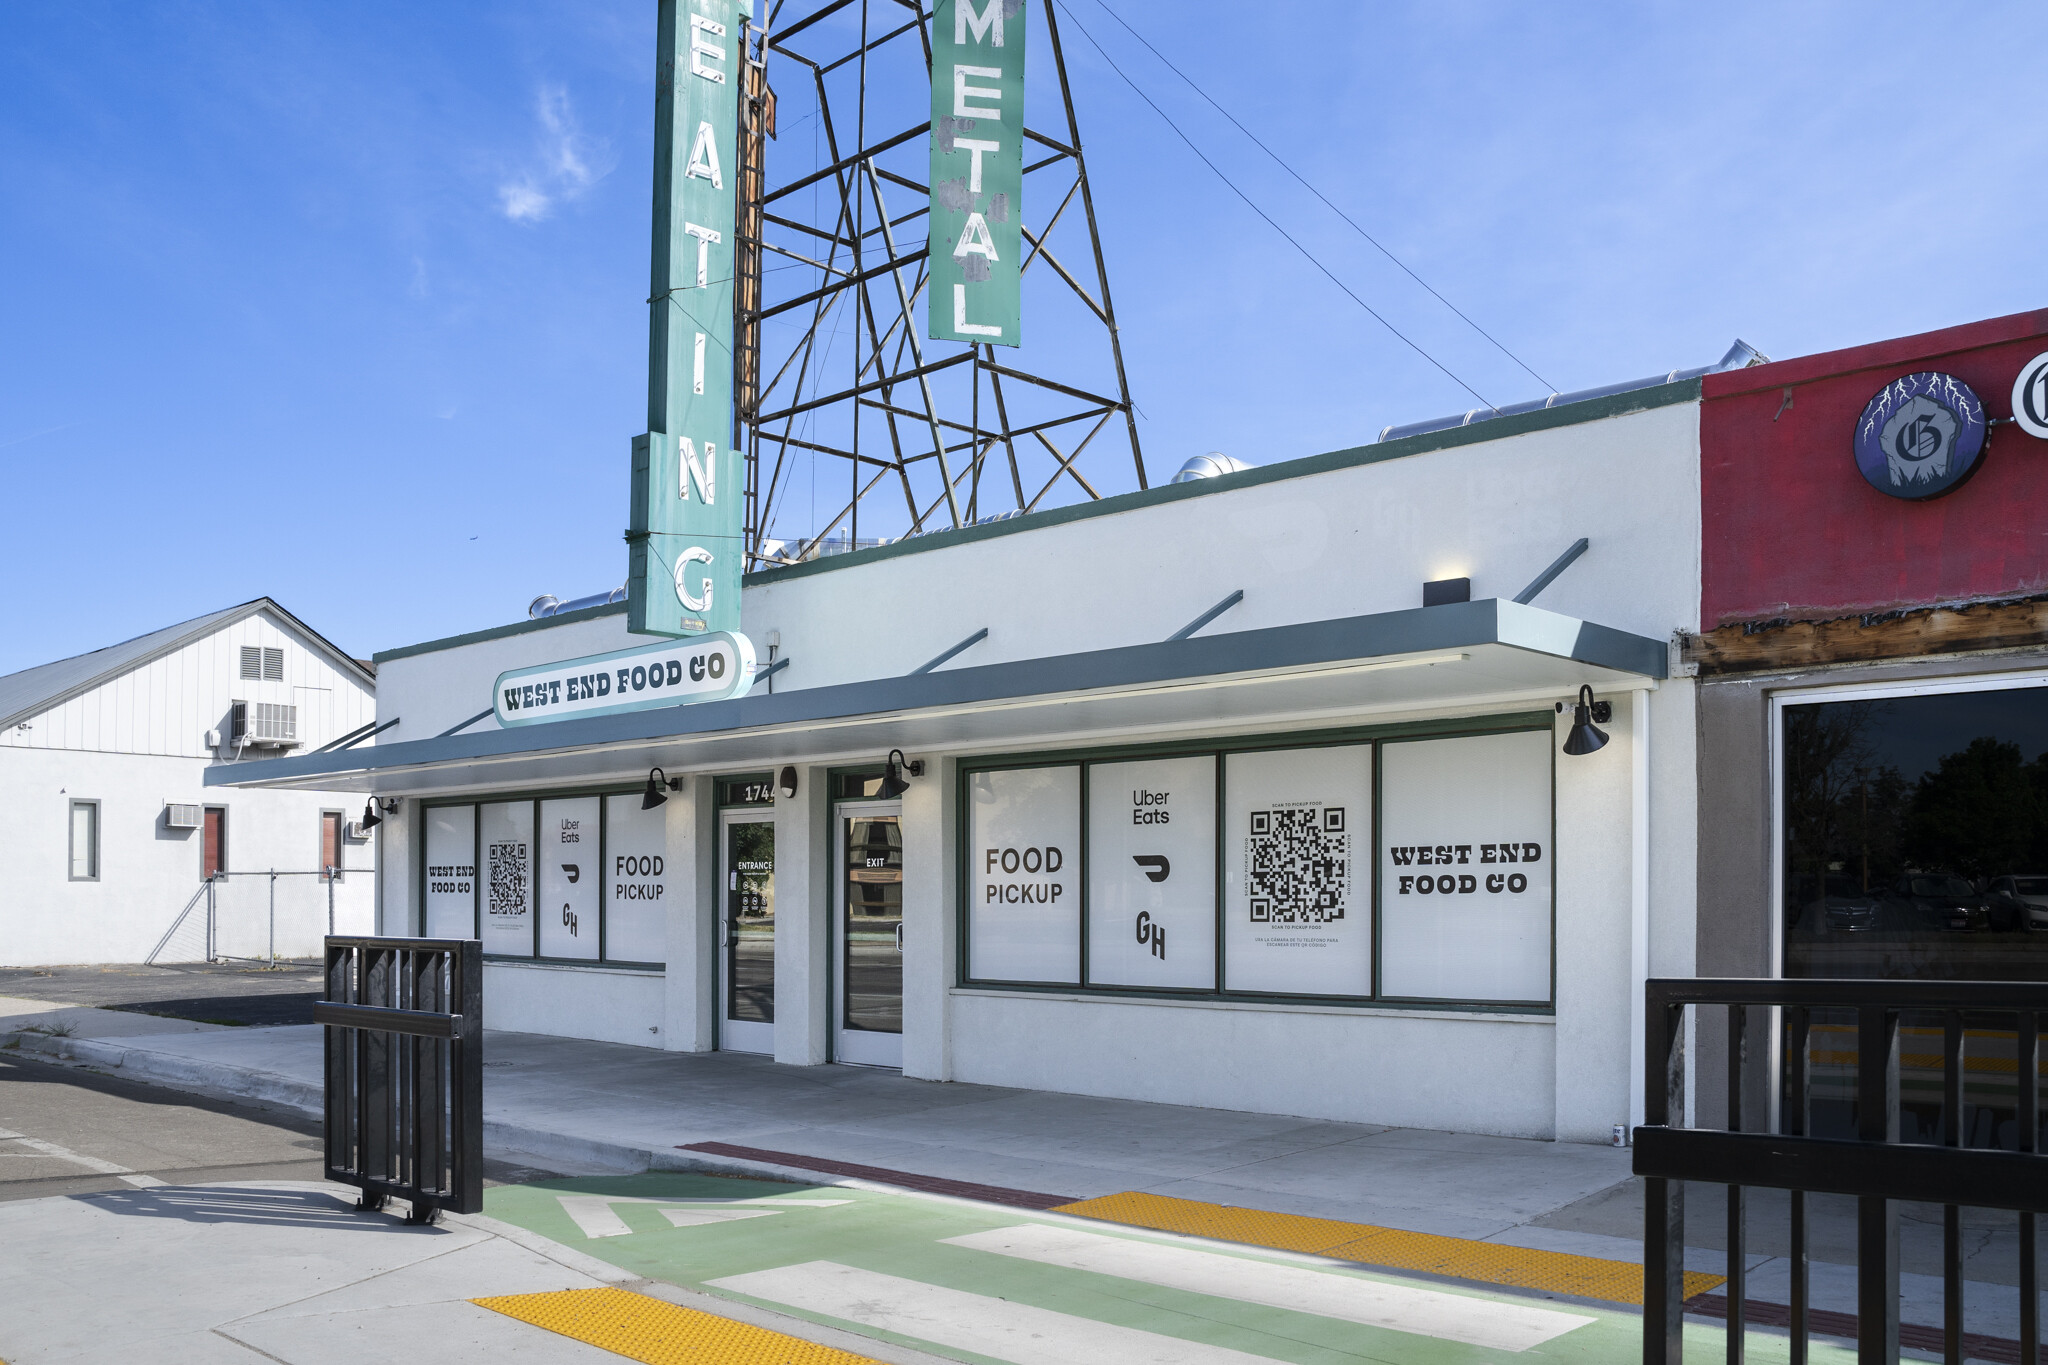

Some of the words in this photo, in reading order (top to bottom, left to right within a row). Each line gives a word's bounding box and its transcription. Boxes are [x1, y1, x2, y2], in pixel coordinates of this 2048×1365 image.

[953, 0, 1004, 337] METAL
[504, 680, 561, 711] WEST
[566, 670, 611, 701] END
[617, 660, 682, 693] FOOD
[689, 652, 726, 682] CO
[1133, 789, 1170, 806] Uber
[561, 818, 579, 830] Uber
[1133, 808, 1170, 825] Eats
[561, 832, 580, 843] Eats
[866, 857, 885, 868] EXIT
[986, 846, 1063, 874] FOOD
[1390, 845, 1472, 866] WEST
[1480, 842, 1541, 863] END
[429, 866, 454, 877] WEST
[456, 865, 474, 877] END
[616, 855, 664, 876] FOOD
[738, 861, 772, 870] ENTRANCE
[431, 882, 455, 893] FOOD
[457, 882, 470, 893] CO
[1399, 874, 1477, 894] FOOD
[1485, 873, 1527, 893] CO
[616, 884, 664, 901] PICKUP
[986, 883, 1063, 904] PICKUP
